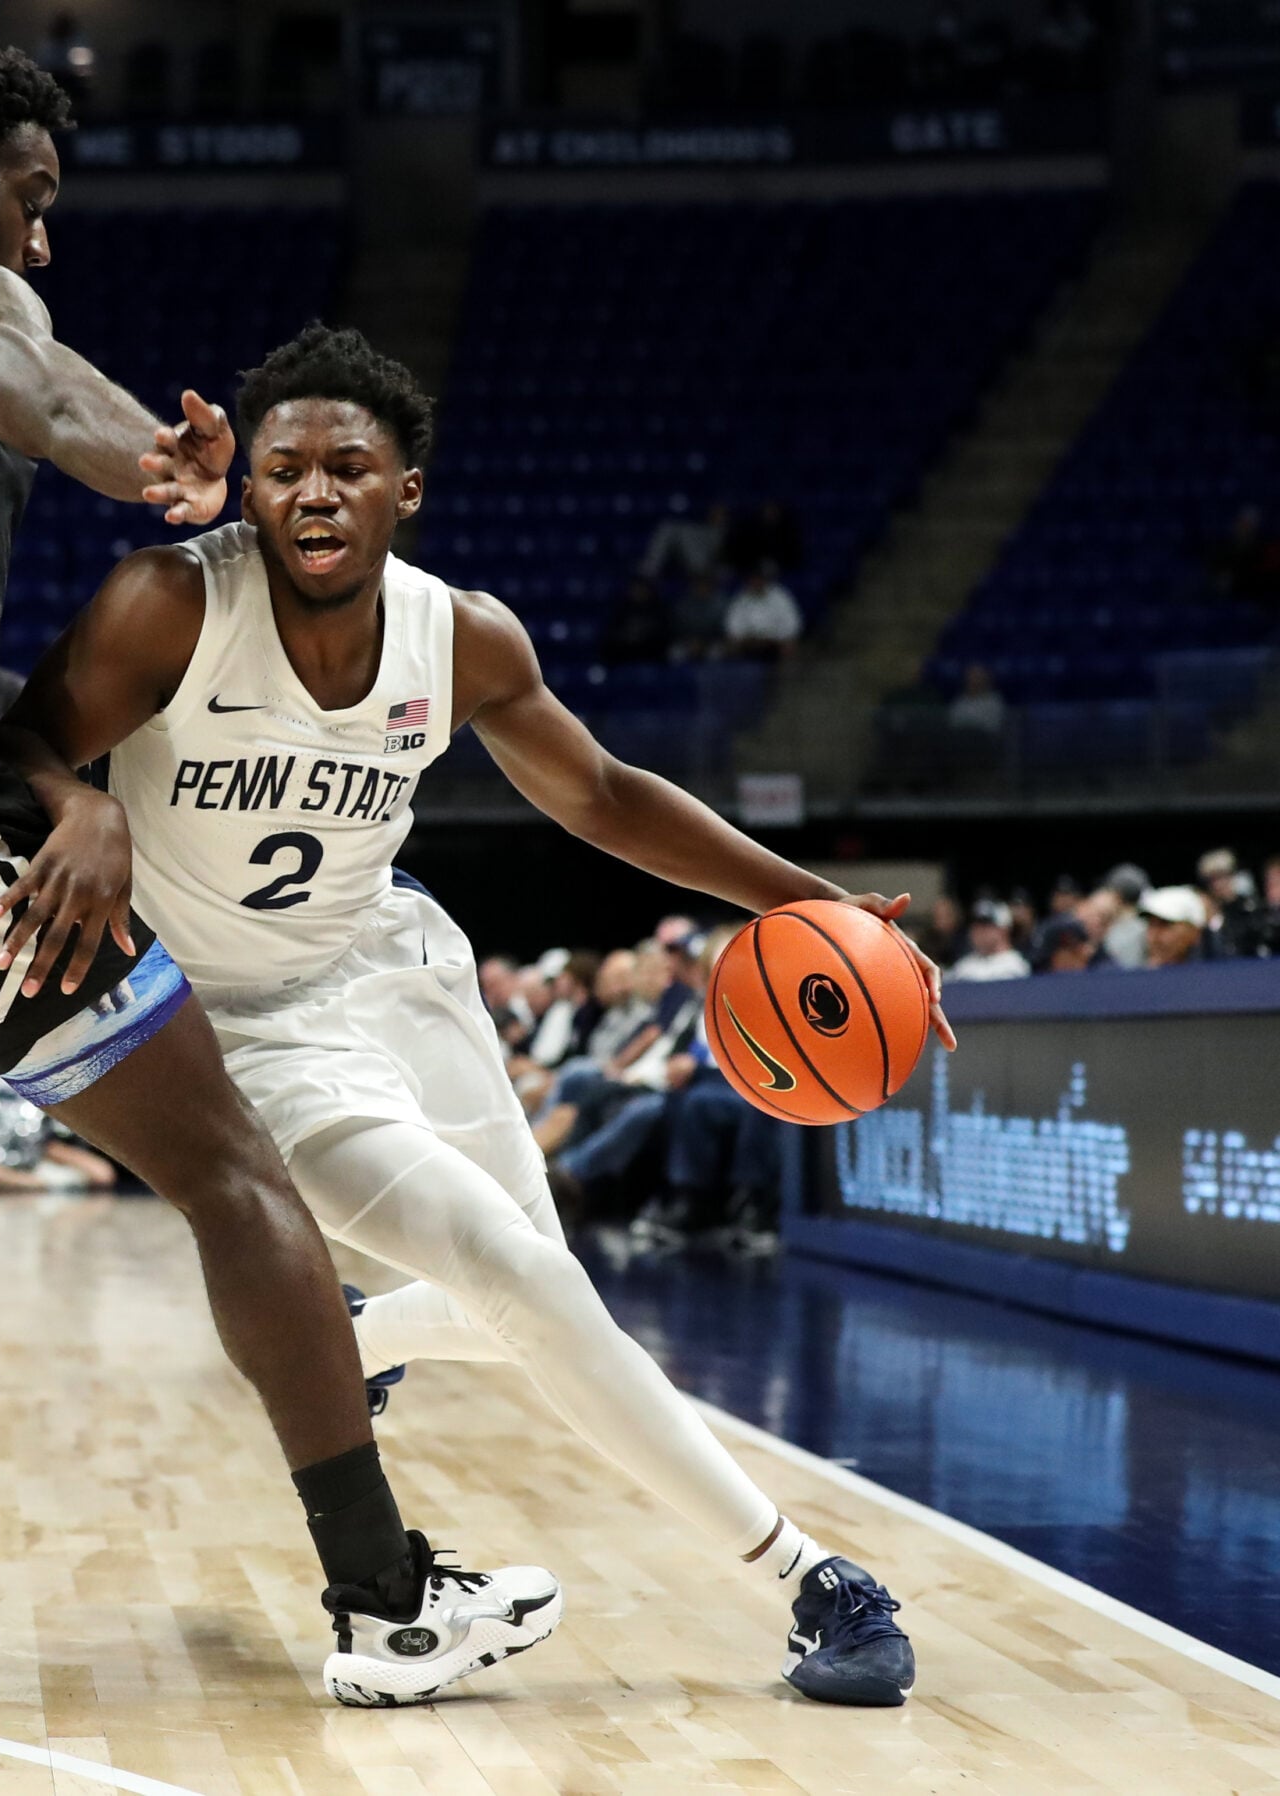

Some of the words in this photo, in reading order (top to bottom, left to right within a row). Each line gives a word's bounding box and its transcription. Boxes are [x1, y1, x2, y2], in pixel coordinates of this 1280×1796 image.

[157, 123, 303, 164] STOOD
[889, 107, 1003, 154] GATE
[170, 755, 297, 811] PENN
[300, 759, 411, 821] STATE
[239, 831, 324, 910] 2
